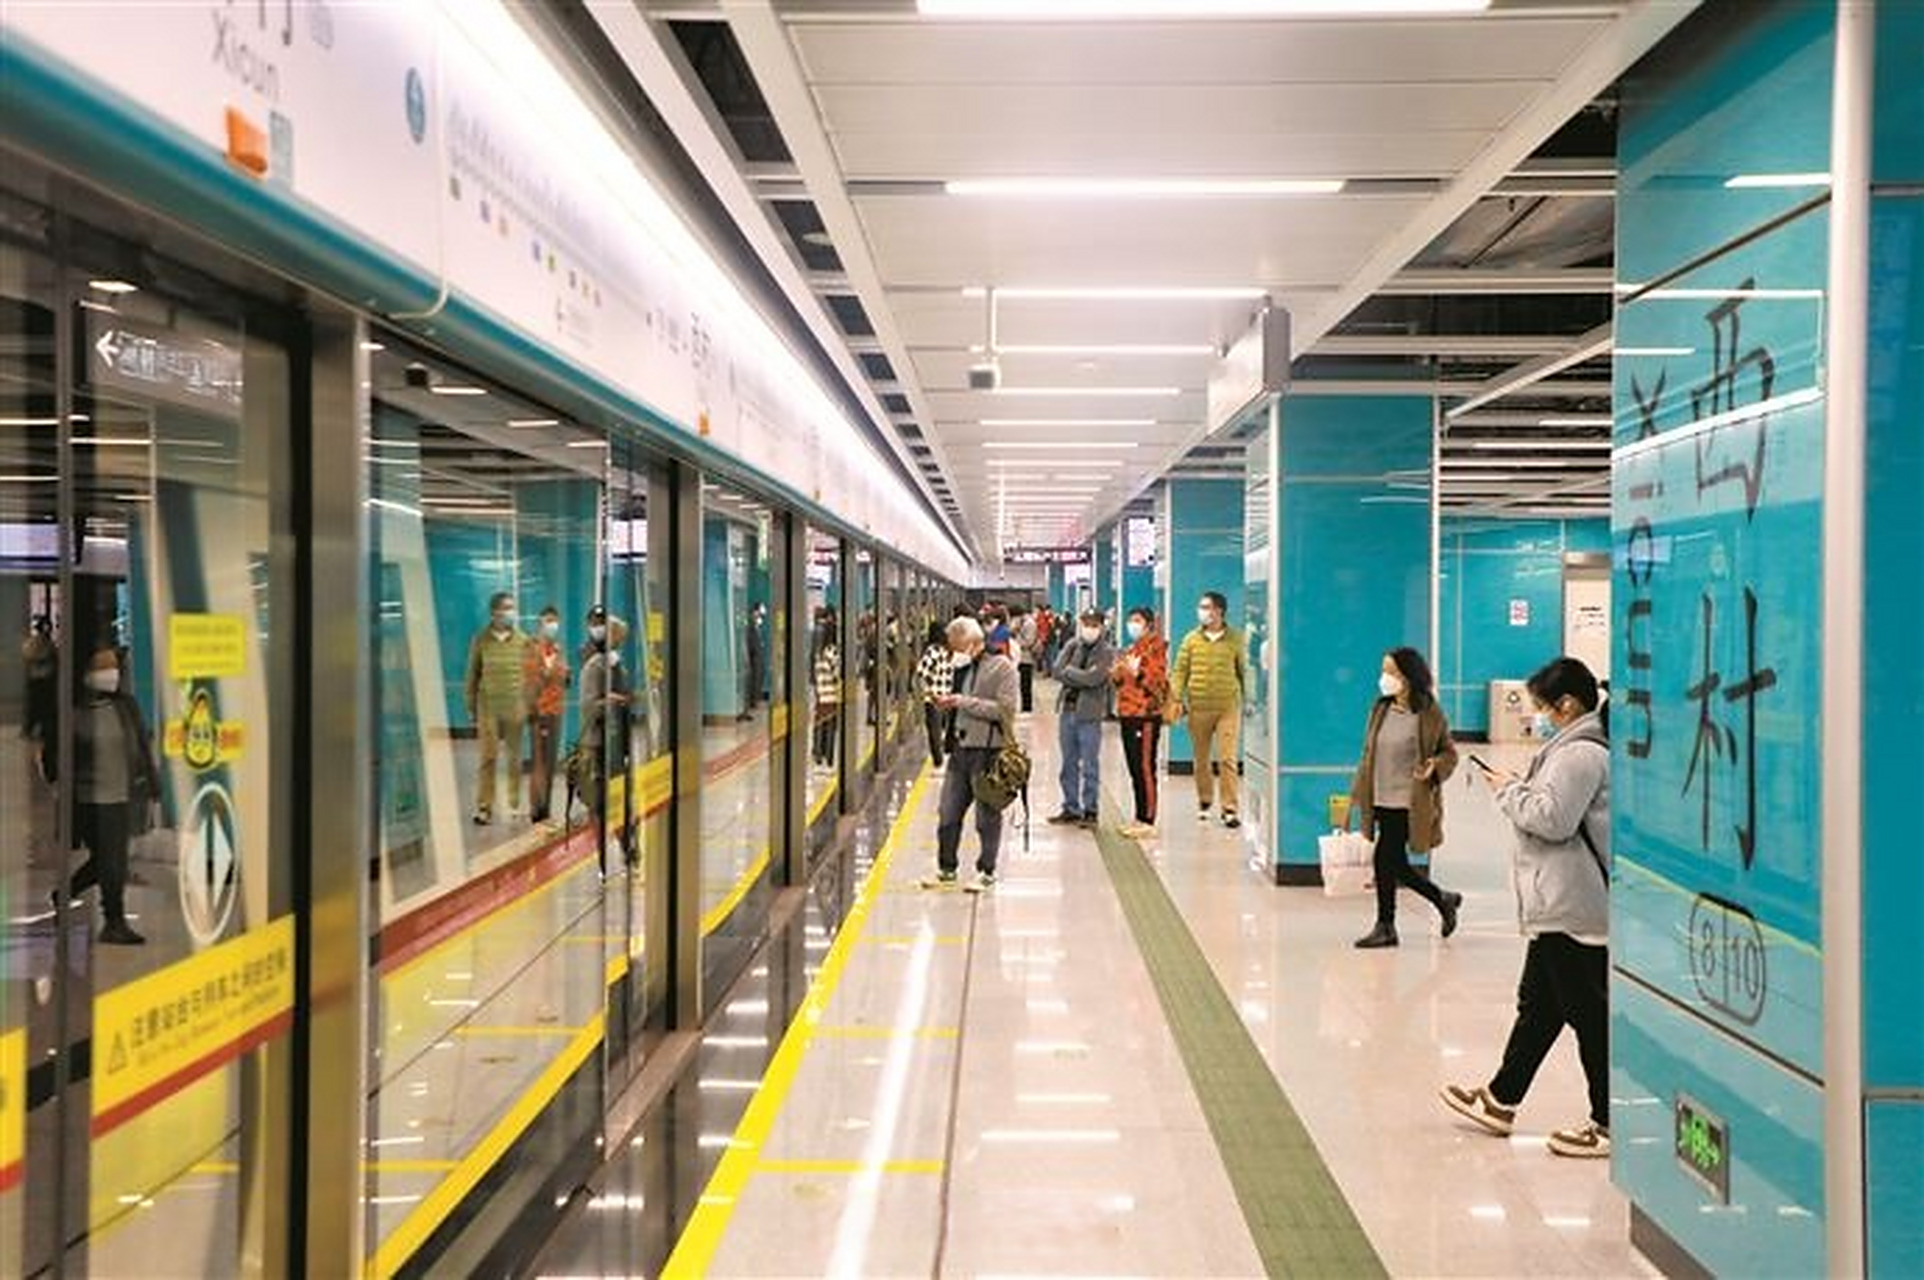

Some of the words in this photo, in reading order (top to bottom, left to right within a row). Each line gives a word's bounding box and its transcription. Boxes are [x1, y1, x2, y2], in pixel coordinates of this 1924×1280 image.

[211, 9, 280, 102] Xicun
[1628, 366, 1667, 758] Xicun
[1681, 276, 1777, 871] 西村
[1702, 918, 1716, 979] 8
[1731, 936, 1760, 1000] 10
